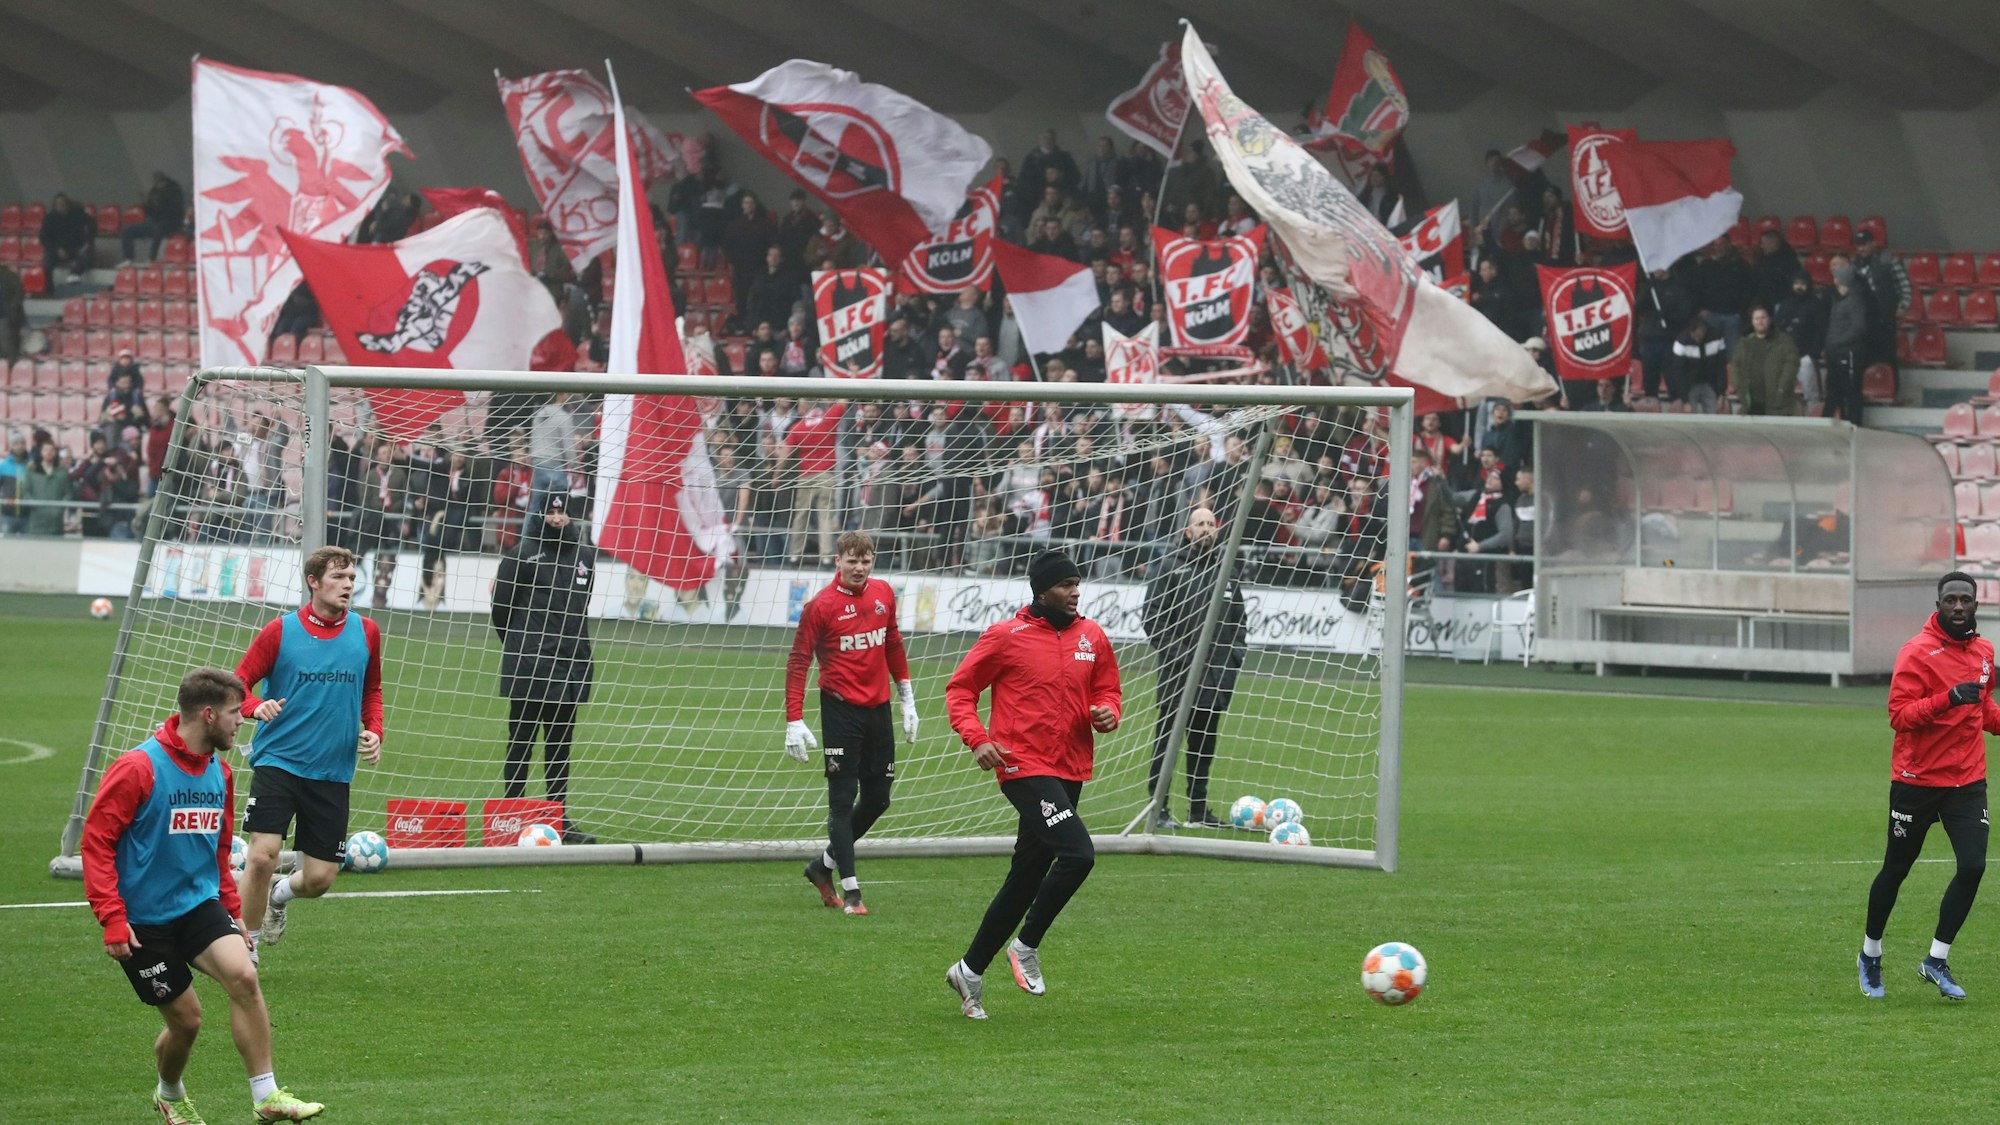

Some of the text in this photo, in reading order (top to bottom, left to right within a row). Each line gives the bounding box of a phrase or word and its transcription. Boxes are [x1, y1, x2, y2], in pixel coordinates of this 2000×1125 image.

[924, 212, 979, 245] .FC
[844, 604, 856, 613] 40
[1085, 590, 1143, 632] Pers
[1074, 652, 1096, 662] REWE
[169, 788, 224, 808] uhlsport
[172, 812, 220, 831] REWE
[1045, 808, 1074, 828] REWE
[139, 961, 168, 979] REWE
